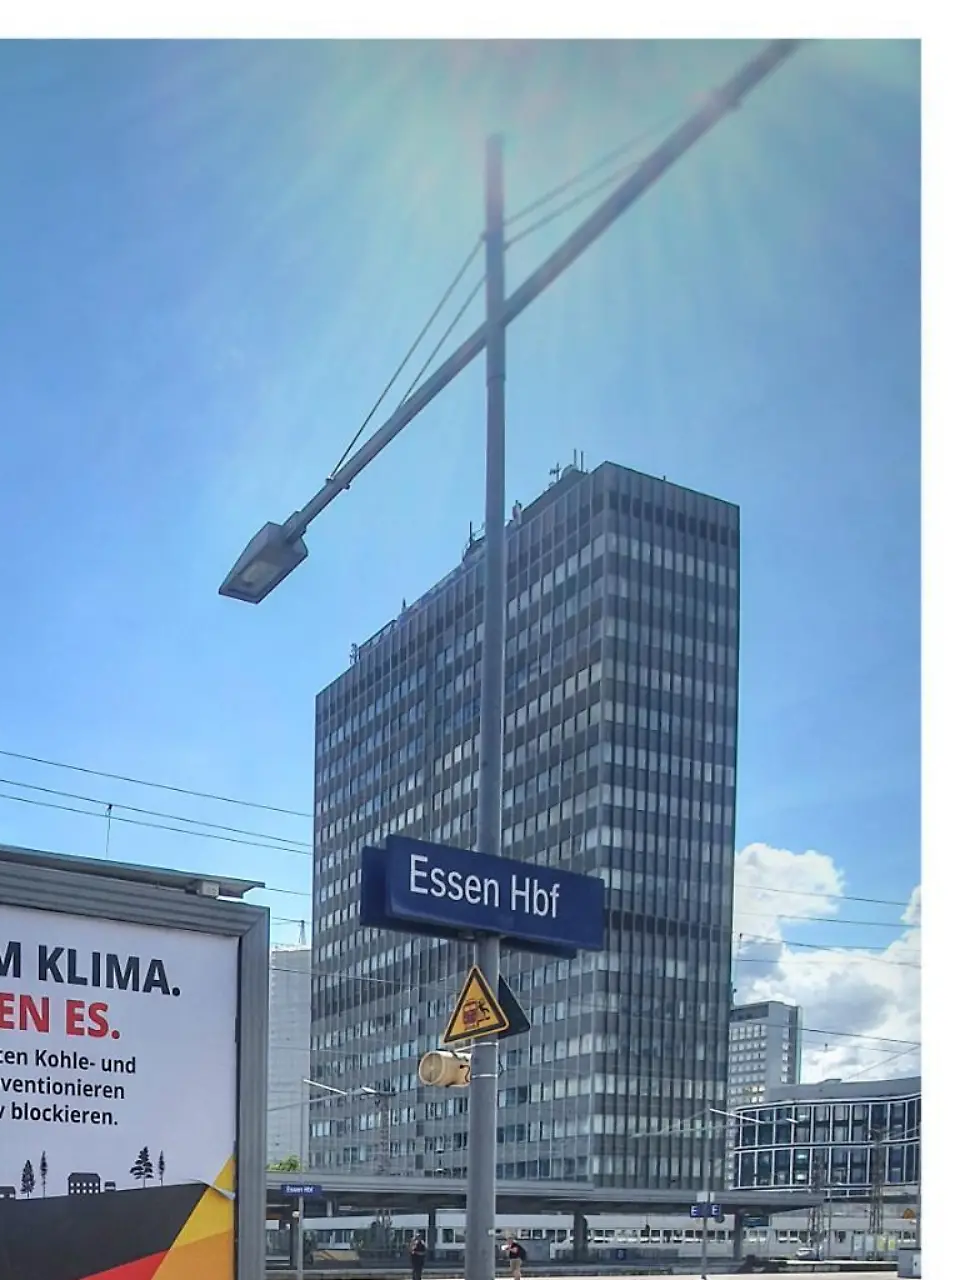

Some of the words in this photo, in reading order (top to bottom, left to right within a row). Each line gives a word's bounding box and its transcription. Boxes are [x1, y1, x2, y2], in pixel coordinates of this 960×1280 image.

[409, 853, 500, 908] Essen
[510, 873, 560, 919] Hbf
[38, 944, 181, 998] KLIMA.
[65, 999, 121, 1040] ES.
[34, 1048, 96, 1071] Kohle-
[101, 1055, 136, 1075] und
[11, 1100, 119, 1126] blockieren.
